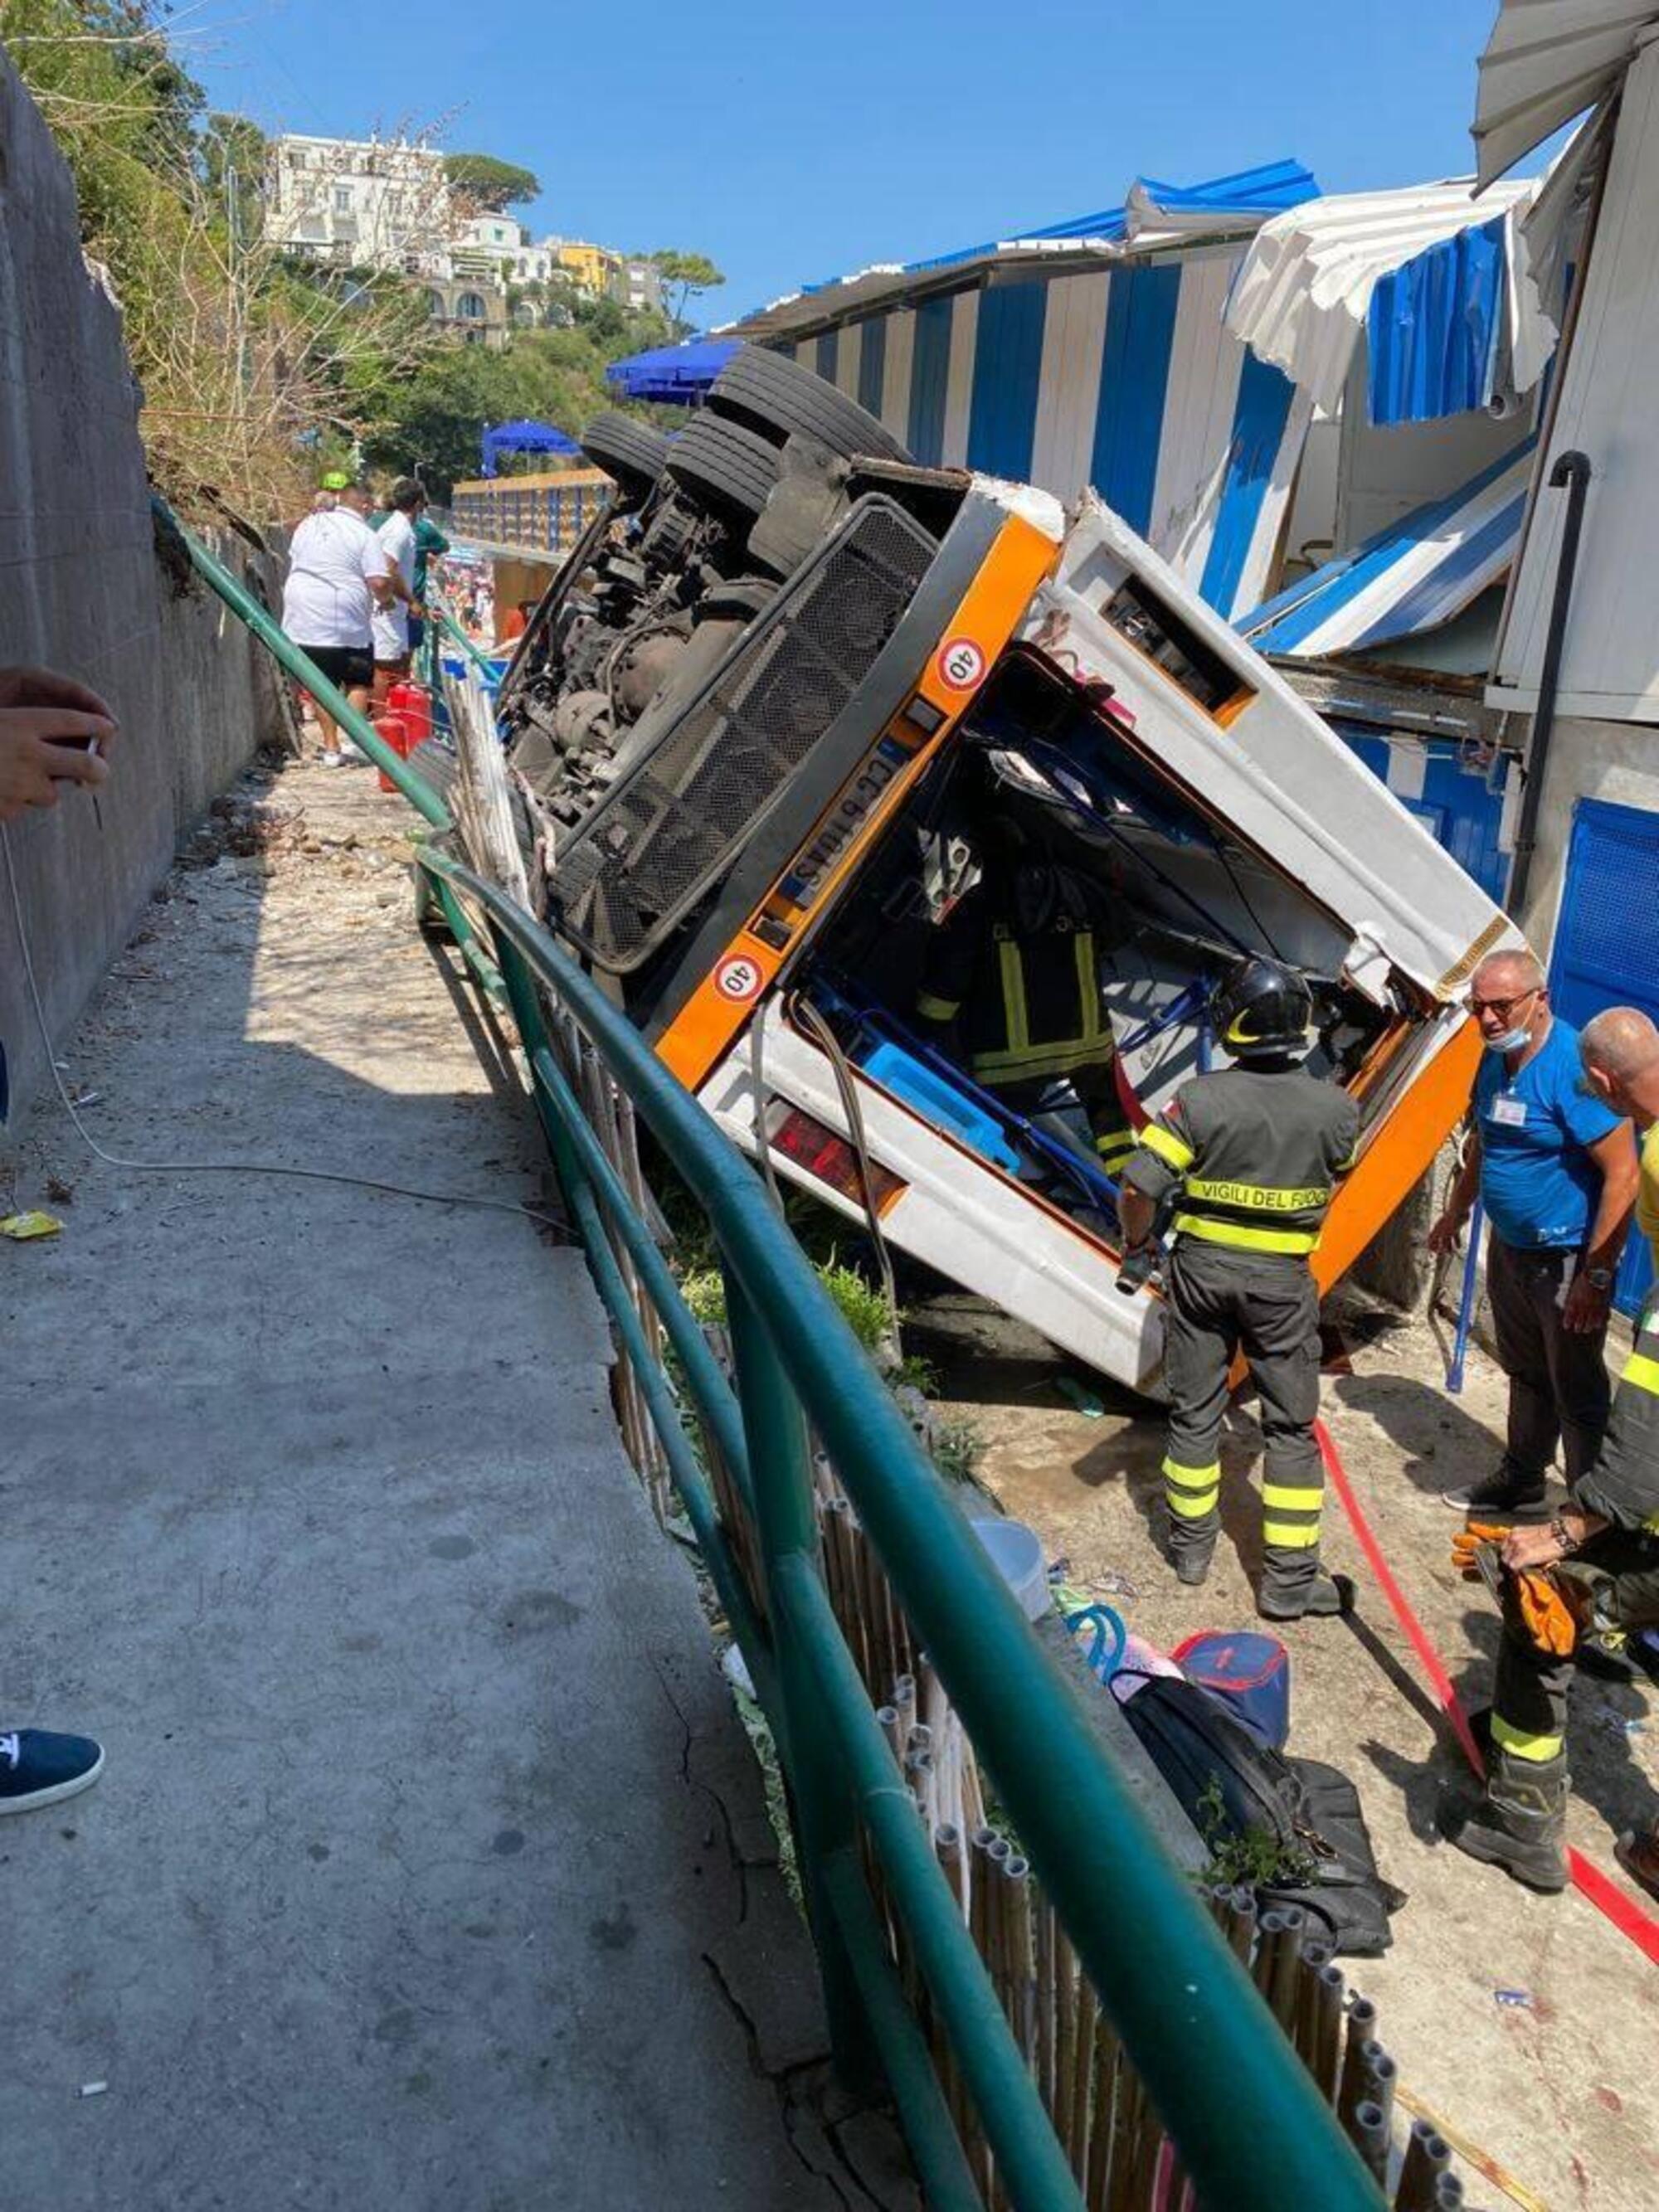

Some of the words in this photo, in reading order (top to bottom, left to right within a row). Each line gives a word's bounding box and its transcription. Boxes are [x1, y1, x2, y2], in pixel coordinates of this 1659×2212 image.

[950, 649, 973, 679] 40
[725, 965, 750, 992] 40
[1203, 1183, 1248, 1204] VIGILI
[1252, 1189, 1287, 1208] DEL
